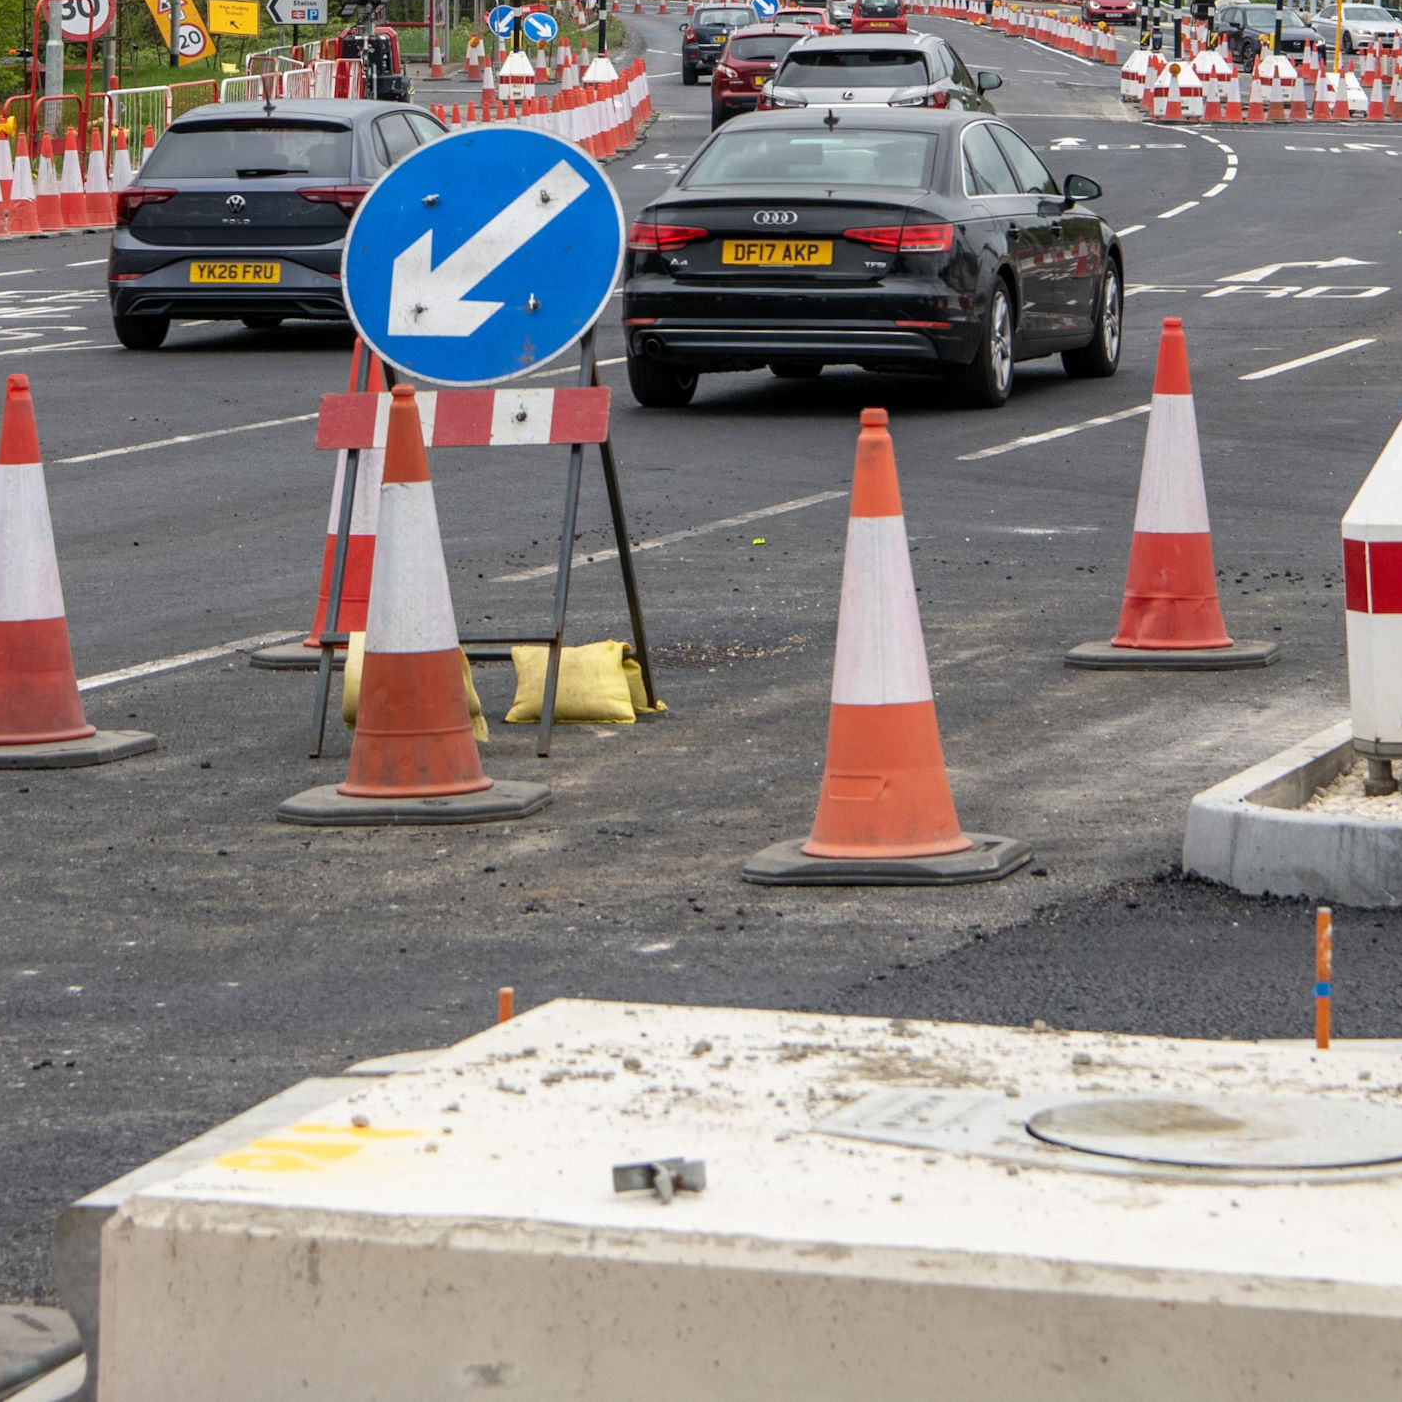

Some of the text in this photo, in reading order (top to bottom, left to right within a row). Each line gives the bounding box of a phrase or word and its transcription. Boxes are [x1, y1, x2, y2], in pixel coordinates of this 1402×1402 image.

[179, 30, 201, 50] 20
[734, 244, 820, 261] DF17 AKP
[670, 257, 688, 266] A4
[197, 264, 274, 279] YK26 FRU
